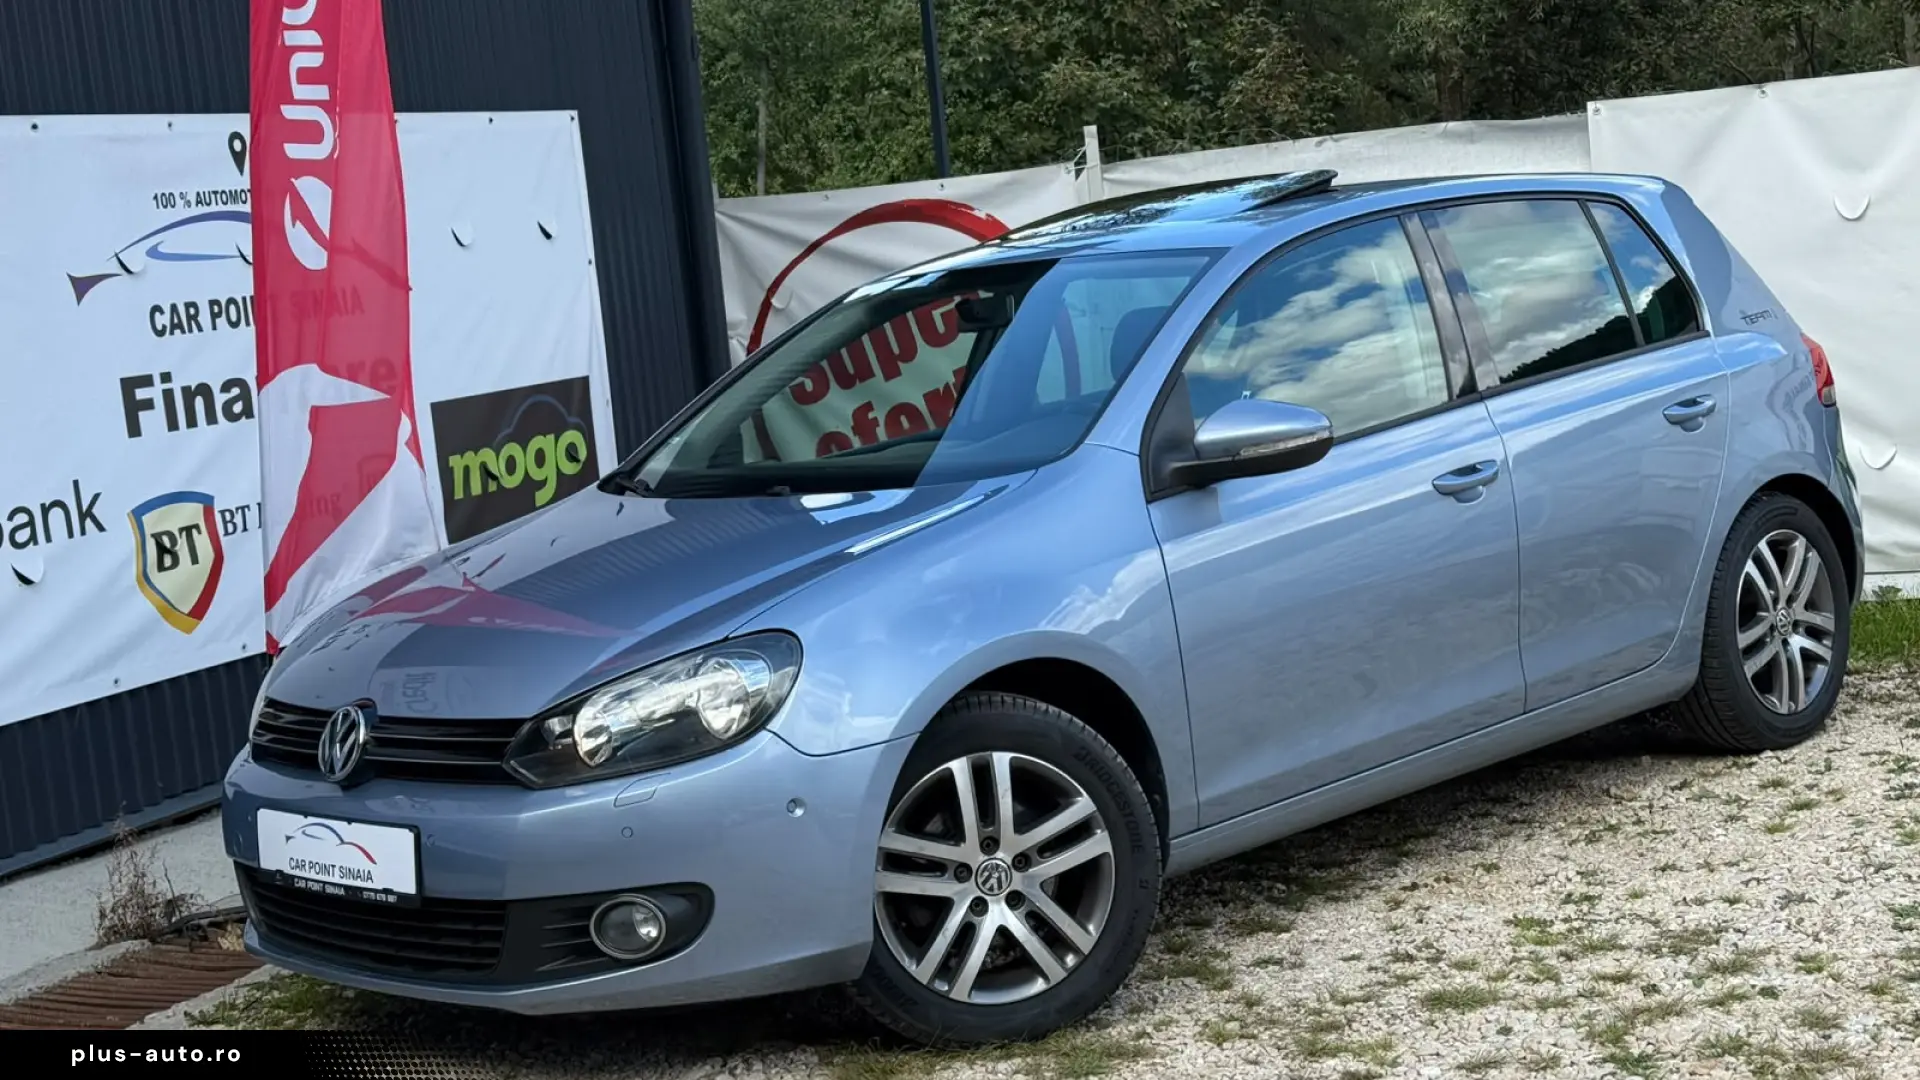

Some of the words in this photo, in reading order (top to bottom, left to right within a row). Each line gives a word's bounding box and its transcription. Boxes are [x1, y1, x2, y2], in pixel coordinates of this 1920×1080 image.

[152, 191, 177, 210] 100
[179, 190, 192, 209] %
[149, 299, 204, 338] CAR
[209, 295, 264, 331] POI
[449, 429, 588, 508] mogo
[0, 479, 107, 551] ank
[219, 503, 253, 537] BT
[151, 522, 203, 574] BT
[289, 857, 307, 872] CAR
[308, 862, 336, 878] POINT
[339, 866, 374, 883] SINAIA
